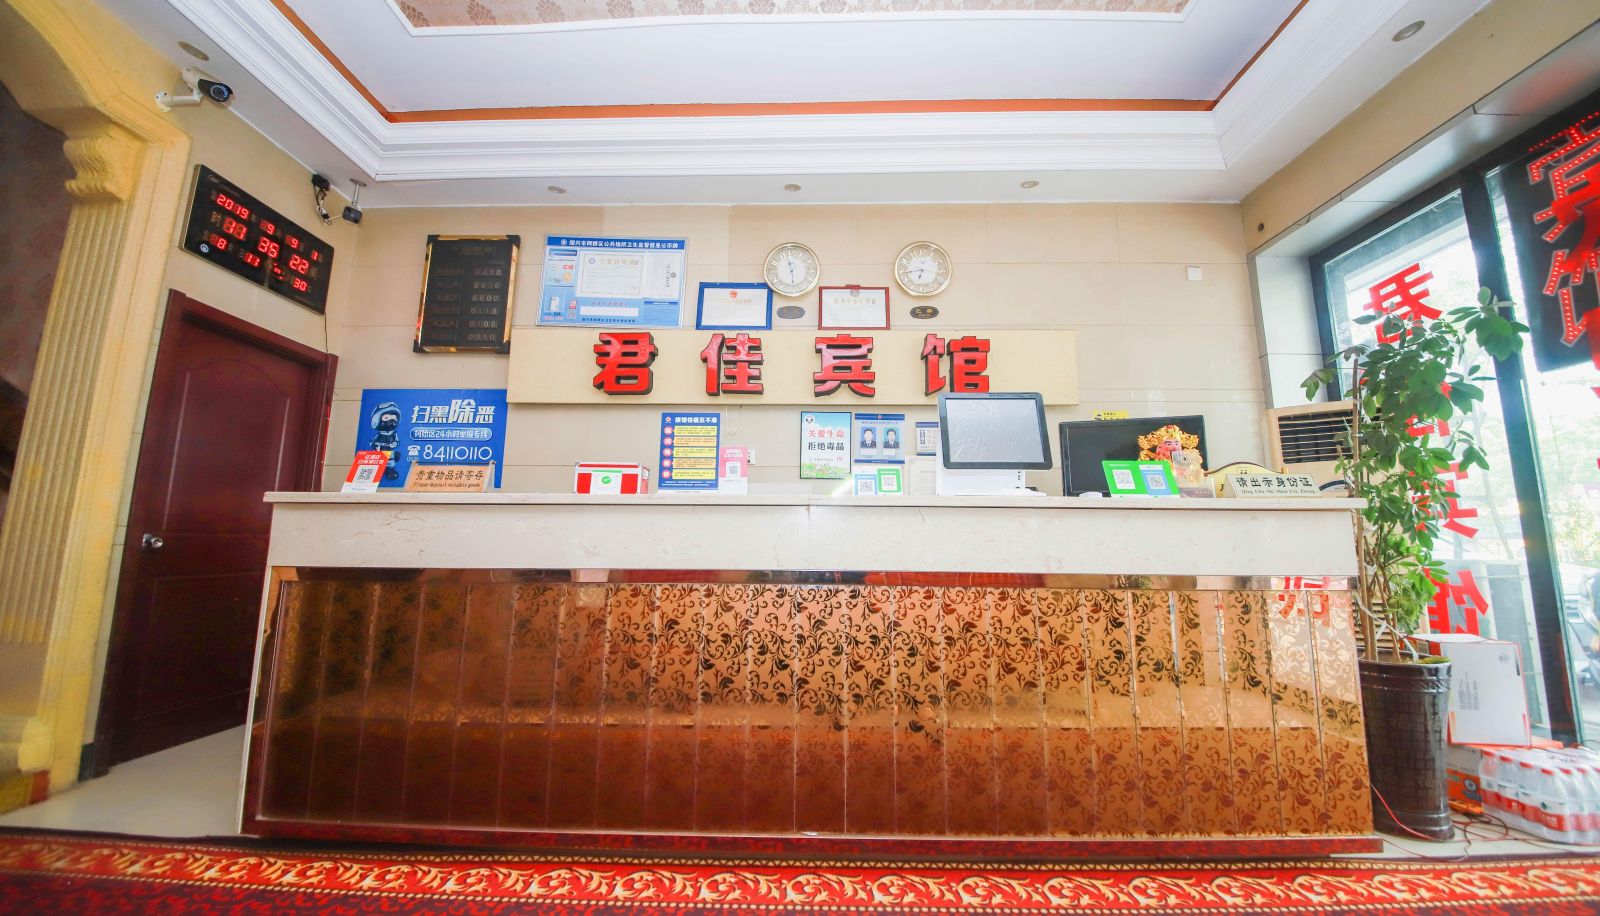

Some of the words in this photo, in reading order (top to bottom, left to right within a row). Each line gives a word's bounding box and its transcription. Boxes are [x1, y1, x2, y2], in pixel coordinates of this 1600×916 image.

[216, 193, 250, 221] 2019
[223, 217, 249, 241] 11
[289, 254, 310, 276] 22
[293, 278, 309, 293] 30
[593, 332, 991, 398] 君佳宾馆
[411, 399, 496, 425] 扫黑除恶
[807, 429, 846, 439] 关爱生命
[422, 444, 493, 463] 84110110
[807, 442, 845, 451] 拒绝毒品
[416, 470, 485, 481] 贵重物品请寄存
[1235, 476, 1313, 488] 请出示身份证
